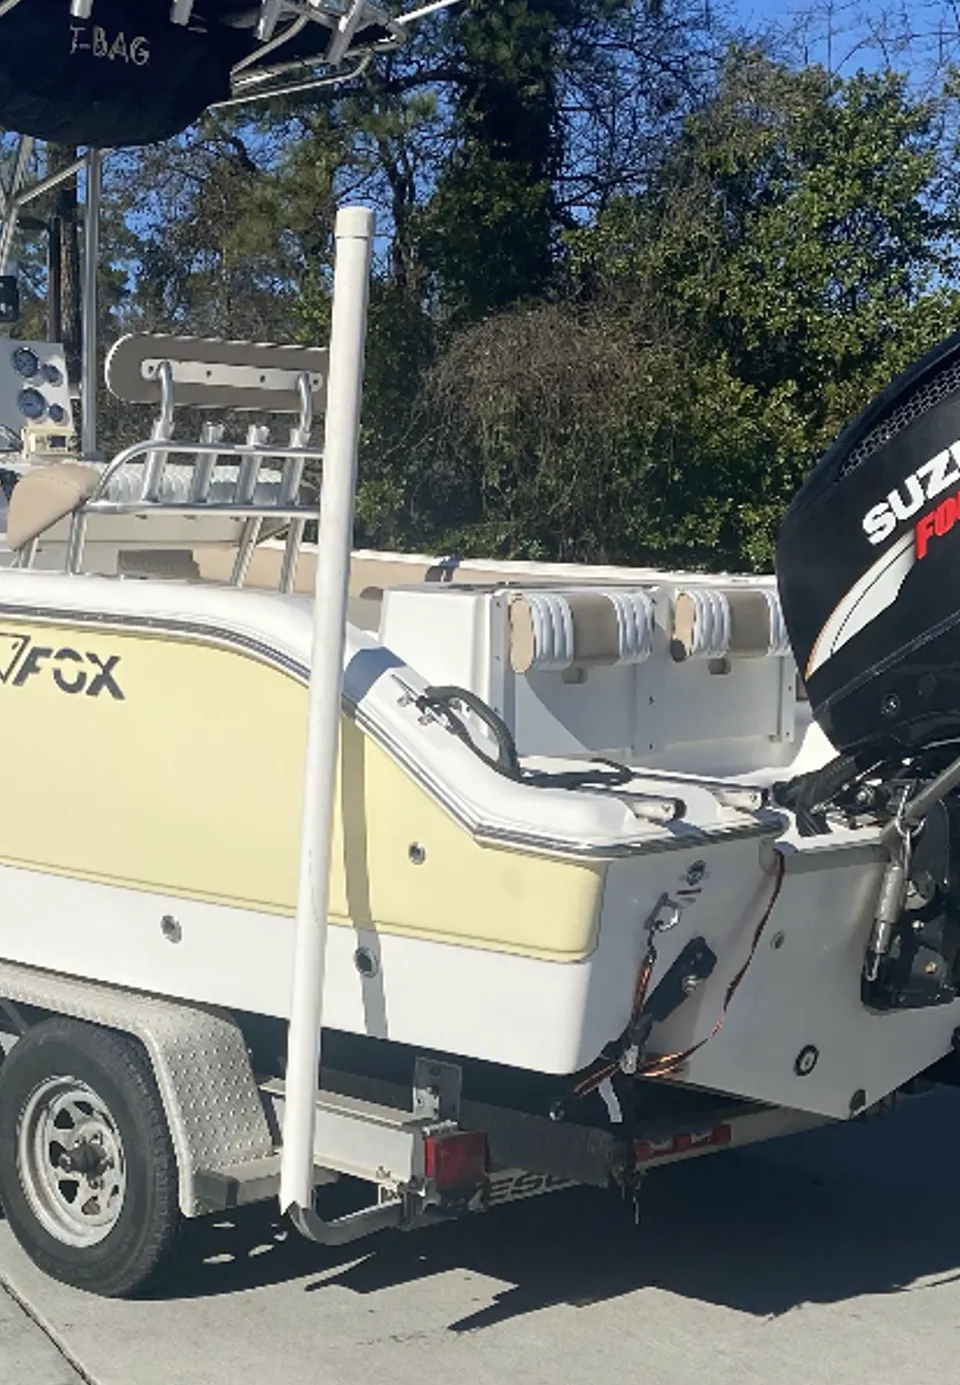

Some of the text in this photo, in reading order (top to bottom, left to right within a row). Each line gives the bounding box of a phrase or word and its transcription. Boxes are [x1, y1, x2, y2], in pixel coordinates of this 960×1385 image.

[69, 23, 150, 66] T-BAG
[862, 439, 960, 546] SUZ
[915, 489, 960, 560] FO
